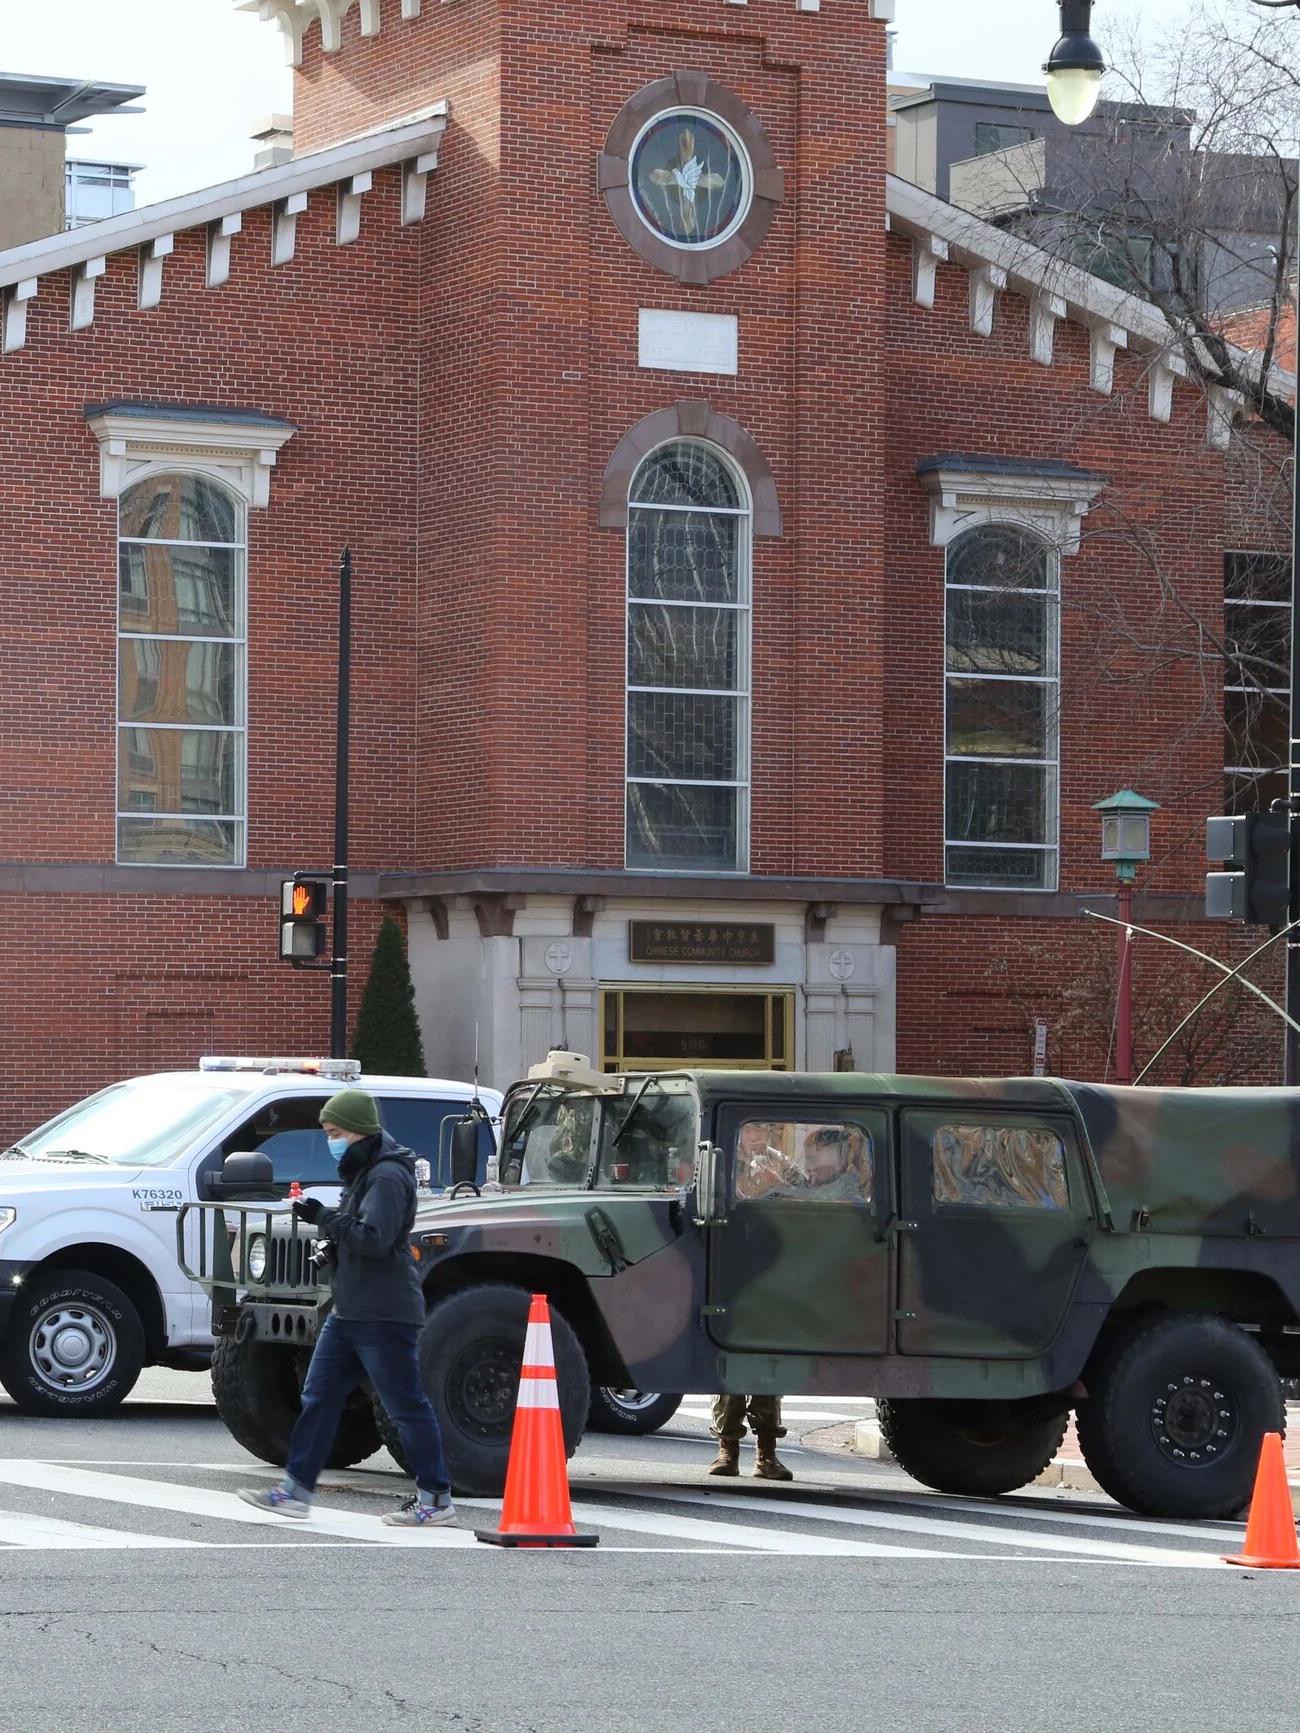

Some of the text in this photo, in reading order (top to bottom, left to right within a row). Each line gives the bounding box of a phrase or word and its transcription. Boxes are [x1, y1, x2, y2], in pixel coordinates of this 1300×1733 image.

[645, 946, 760, 958] CHINESE COMMUNITY CHURCH
[132, 1189, 183, 1200] K76320
[30, 1288, 122, 1320] GOODYEAR
